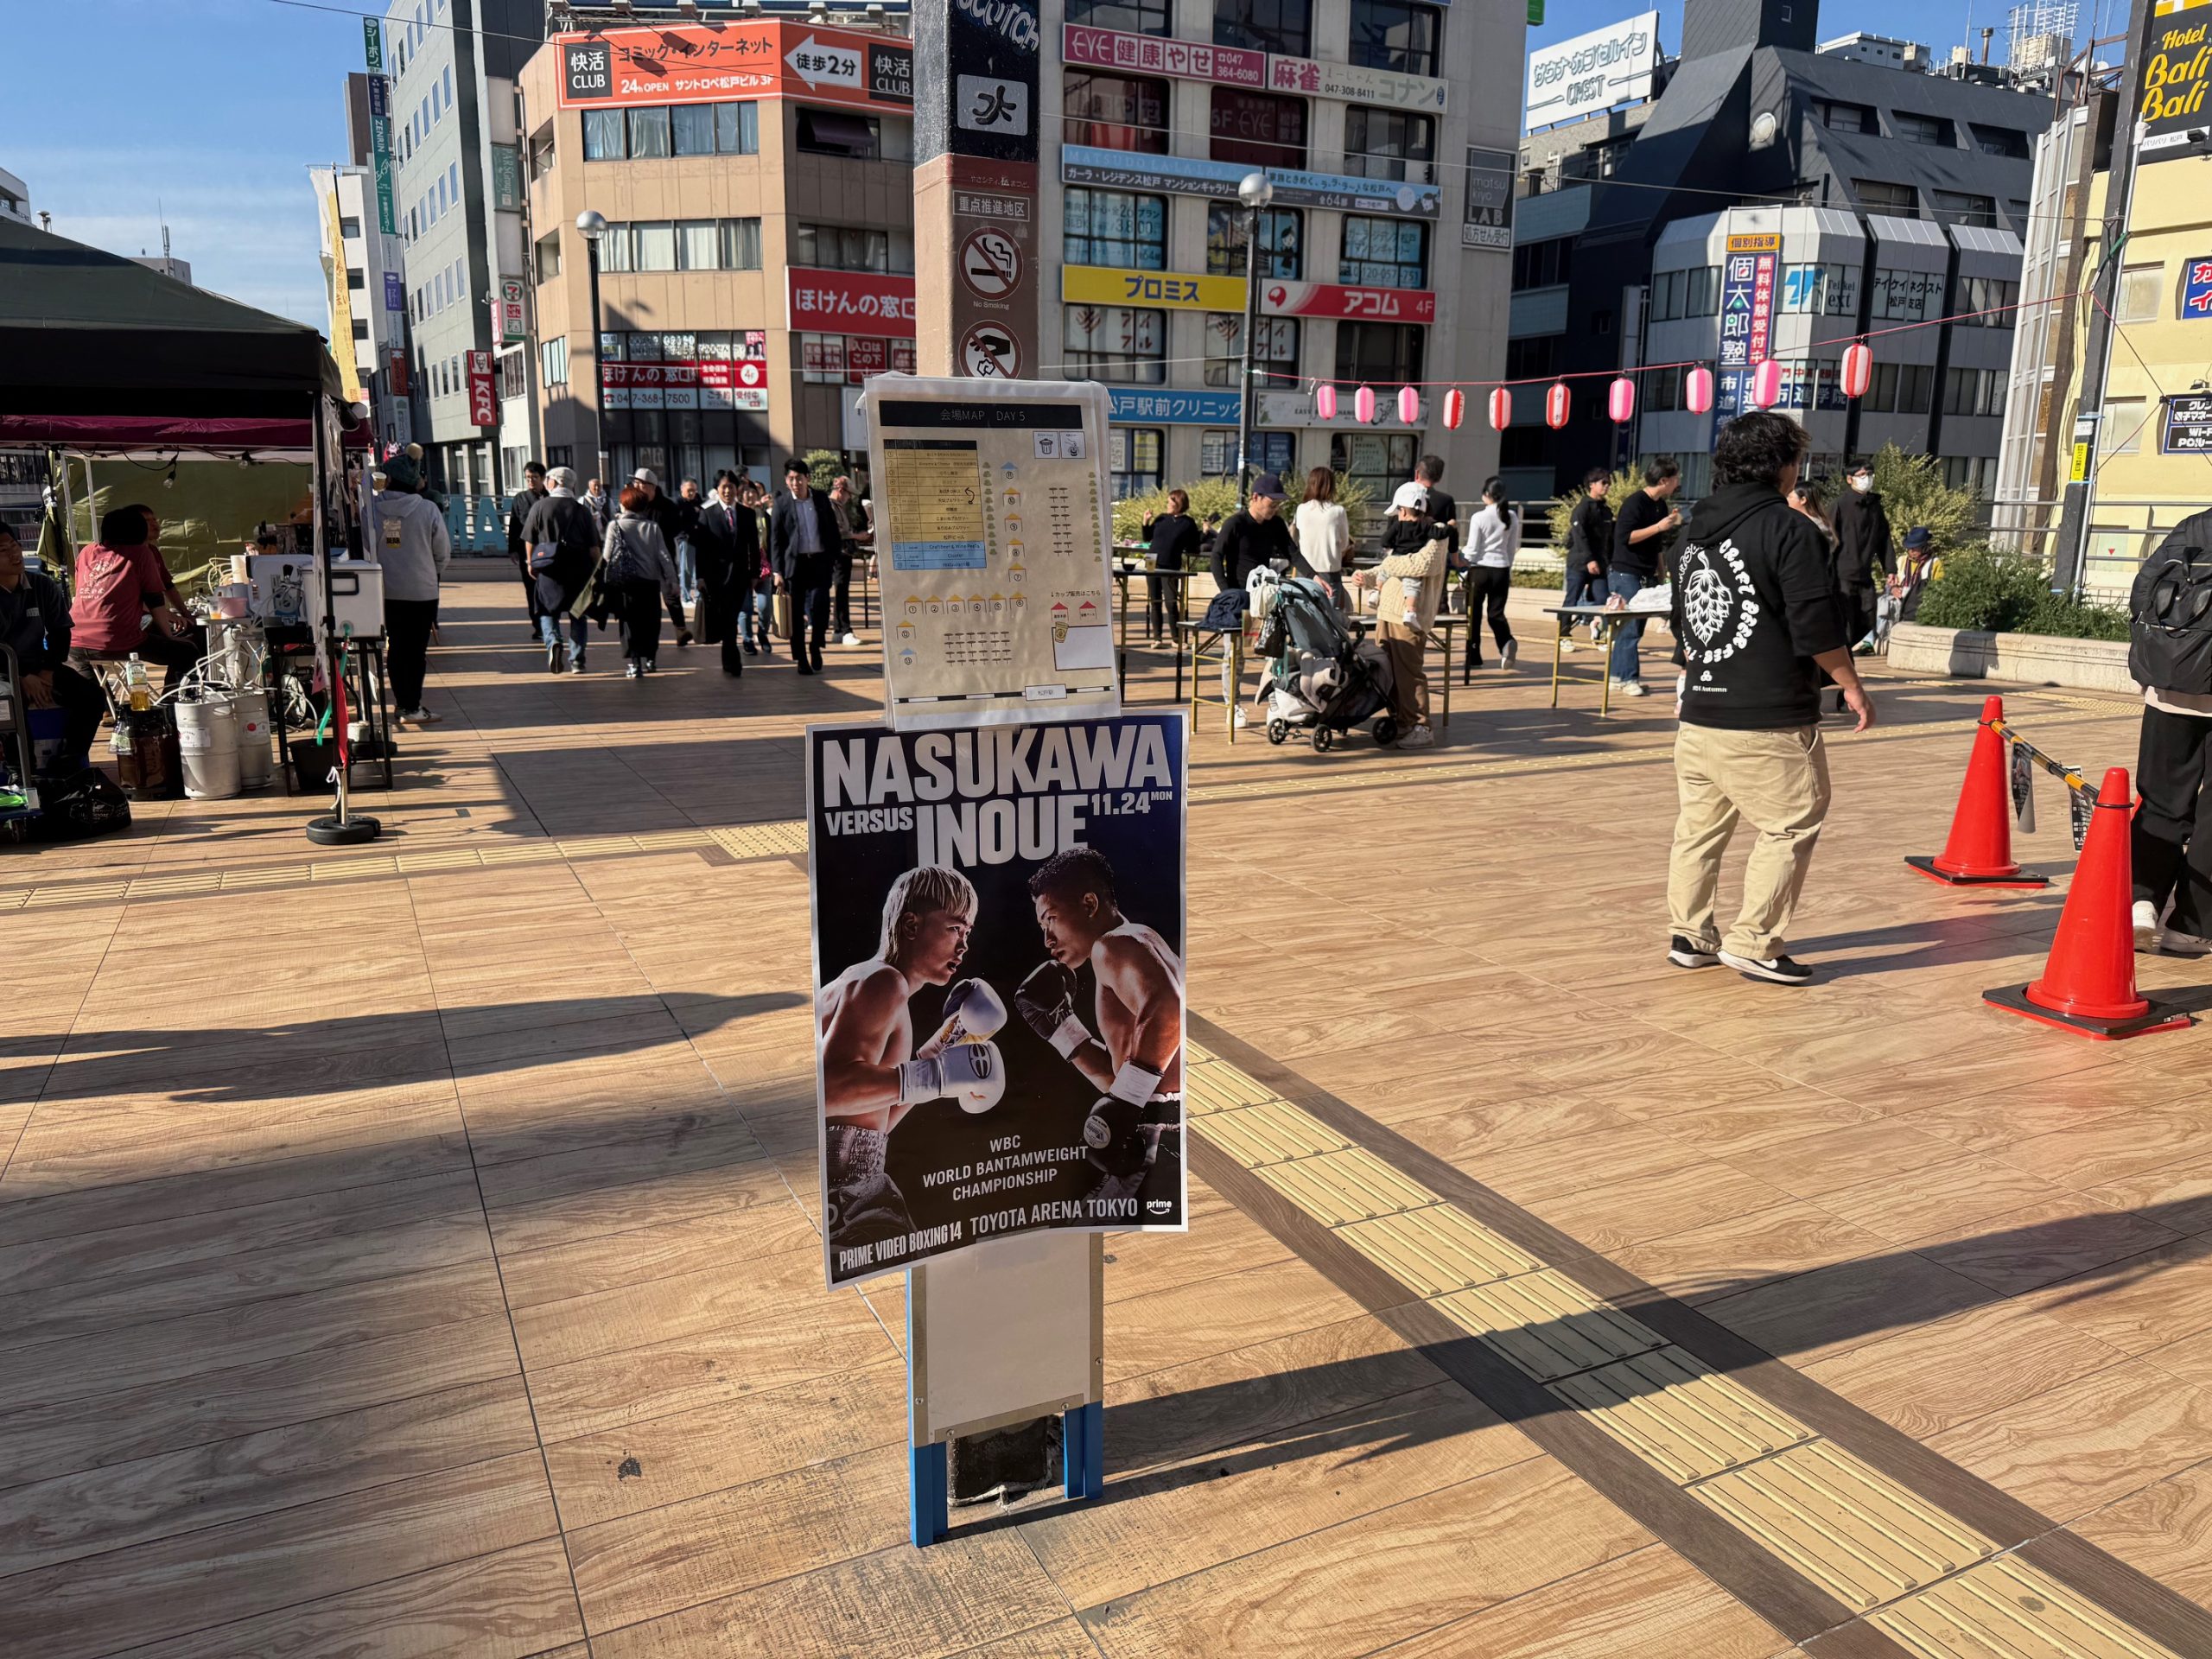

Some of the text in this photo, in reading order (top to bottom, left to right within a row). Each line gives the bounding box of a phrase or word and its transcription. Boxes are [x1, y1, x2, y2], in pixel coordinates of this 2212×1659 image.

[2162, 23, 2207, 50] Hotel
[571, 51, 604, 72] 快活
[619, 37, 773, 63] コミック・インターネット
[1115, 37, 1211, 74] 健康やせ
[1226, 54, 1243, 65] 047
[1534, 32, 1647, 87] サウナ・カプセルイン
[796, 53, 856, 77] 徒歩2分
[875, 54, 911, 78] 快活
[1217, 68, 1259, 81] 364-6080
[1273, 60, 1321, 92] 麻雀
[2145, 46, 2212, 90] Bali
[572, 74, 606, 89] CLUB
[643, 82, 669, 92] OPEN
[875, 78, 911, 94] CLUB
[1325, 84, 1375, 99] 047-308-8411
[1378, 78, 1435, 105] コナン
[1567, 74, 1605, 105] CREST
[2142, 79, 2209, 122] Bali
[375, 119, 385, 153] ZENRIN
[1473, 176, 1505, 189] matsu
[958, 195, 1026, 217] 重点推進地区
[1472, 188, 1492, 203] kiyo
[1468, 206, 1503, 226] LAB
[1465, 226, 1509, 245] 処方せん受付
[1731, 236, 1776, 249] 個別指導
[1125, 275, 1200, 302] プロミス
[796, 288, 916, 320] ほけんの窓口
[983, 302, 1010, 311] Smoking
[1344, 290, 1433, 315] アコム 4F
[1720, 256, 1755, 365] 個太郎塾
[1750, 257, 1773, 364] 無料体験受付中
[1889, 295, 1923, 311] 松戸支店
[853, 353, 881, 365] この下
[477, 381, 492, 424] KFC
[940, 410, 1026, 423] 会場MAP DAY 5
[823, 724, 1173, 808] NASUKAWA
[824, 806, 913, 836] VERSUS
[916, 791, 1173, 868] INOUE 11.24 MON
[989, 1135, 1021, 1153] WBC
[923, 1146, 1089, 1188] WORLD BANTAMWEIGHT
[952, 1168, 1058, 1202] CHAMPIONSHIP
[1147, 1198, 1173, 1210] prime
[970, 1198, 1138, 1236] TOYOTA ARENA TOKYO
[839, 1220, 963, 1272] PRIME VIDEO BOXING 14
